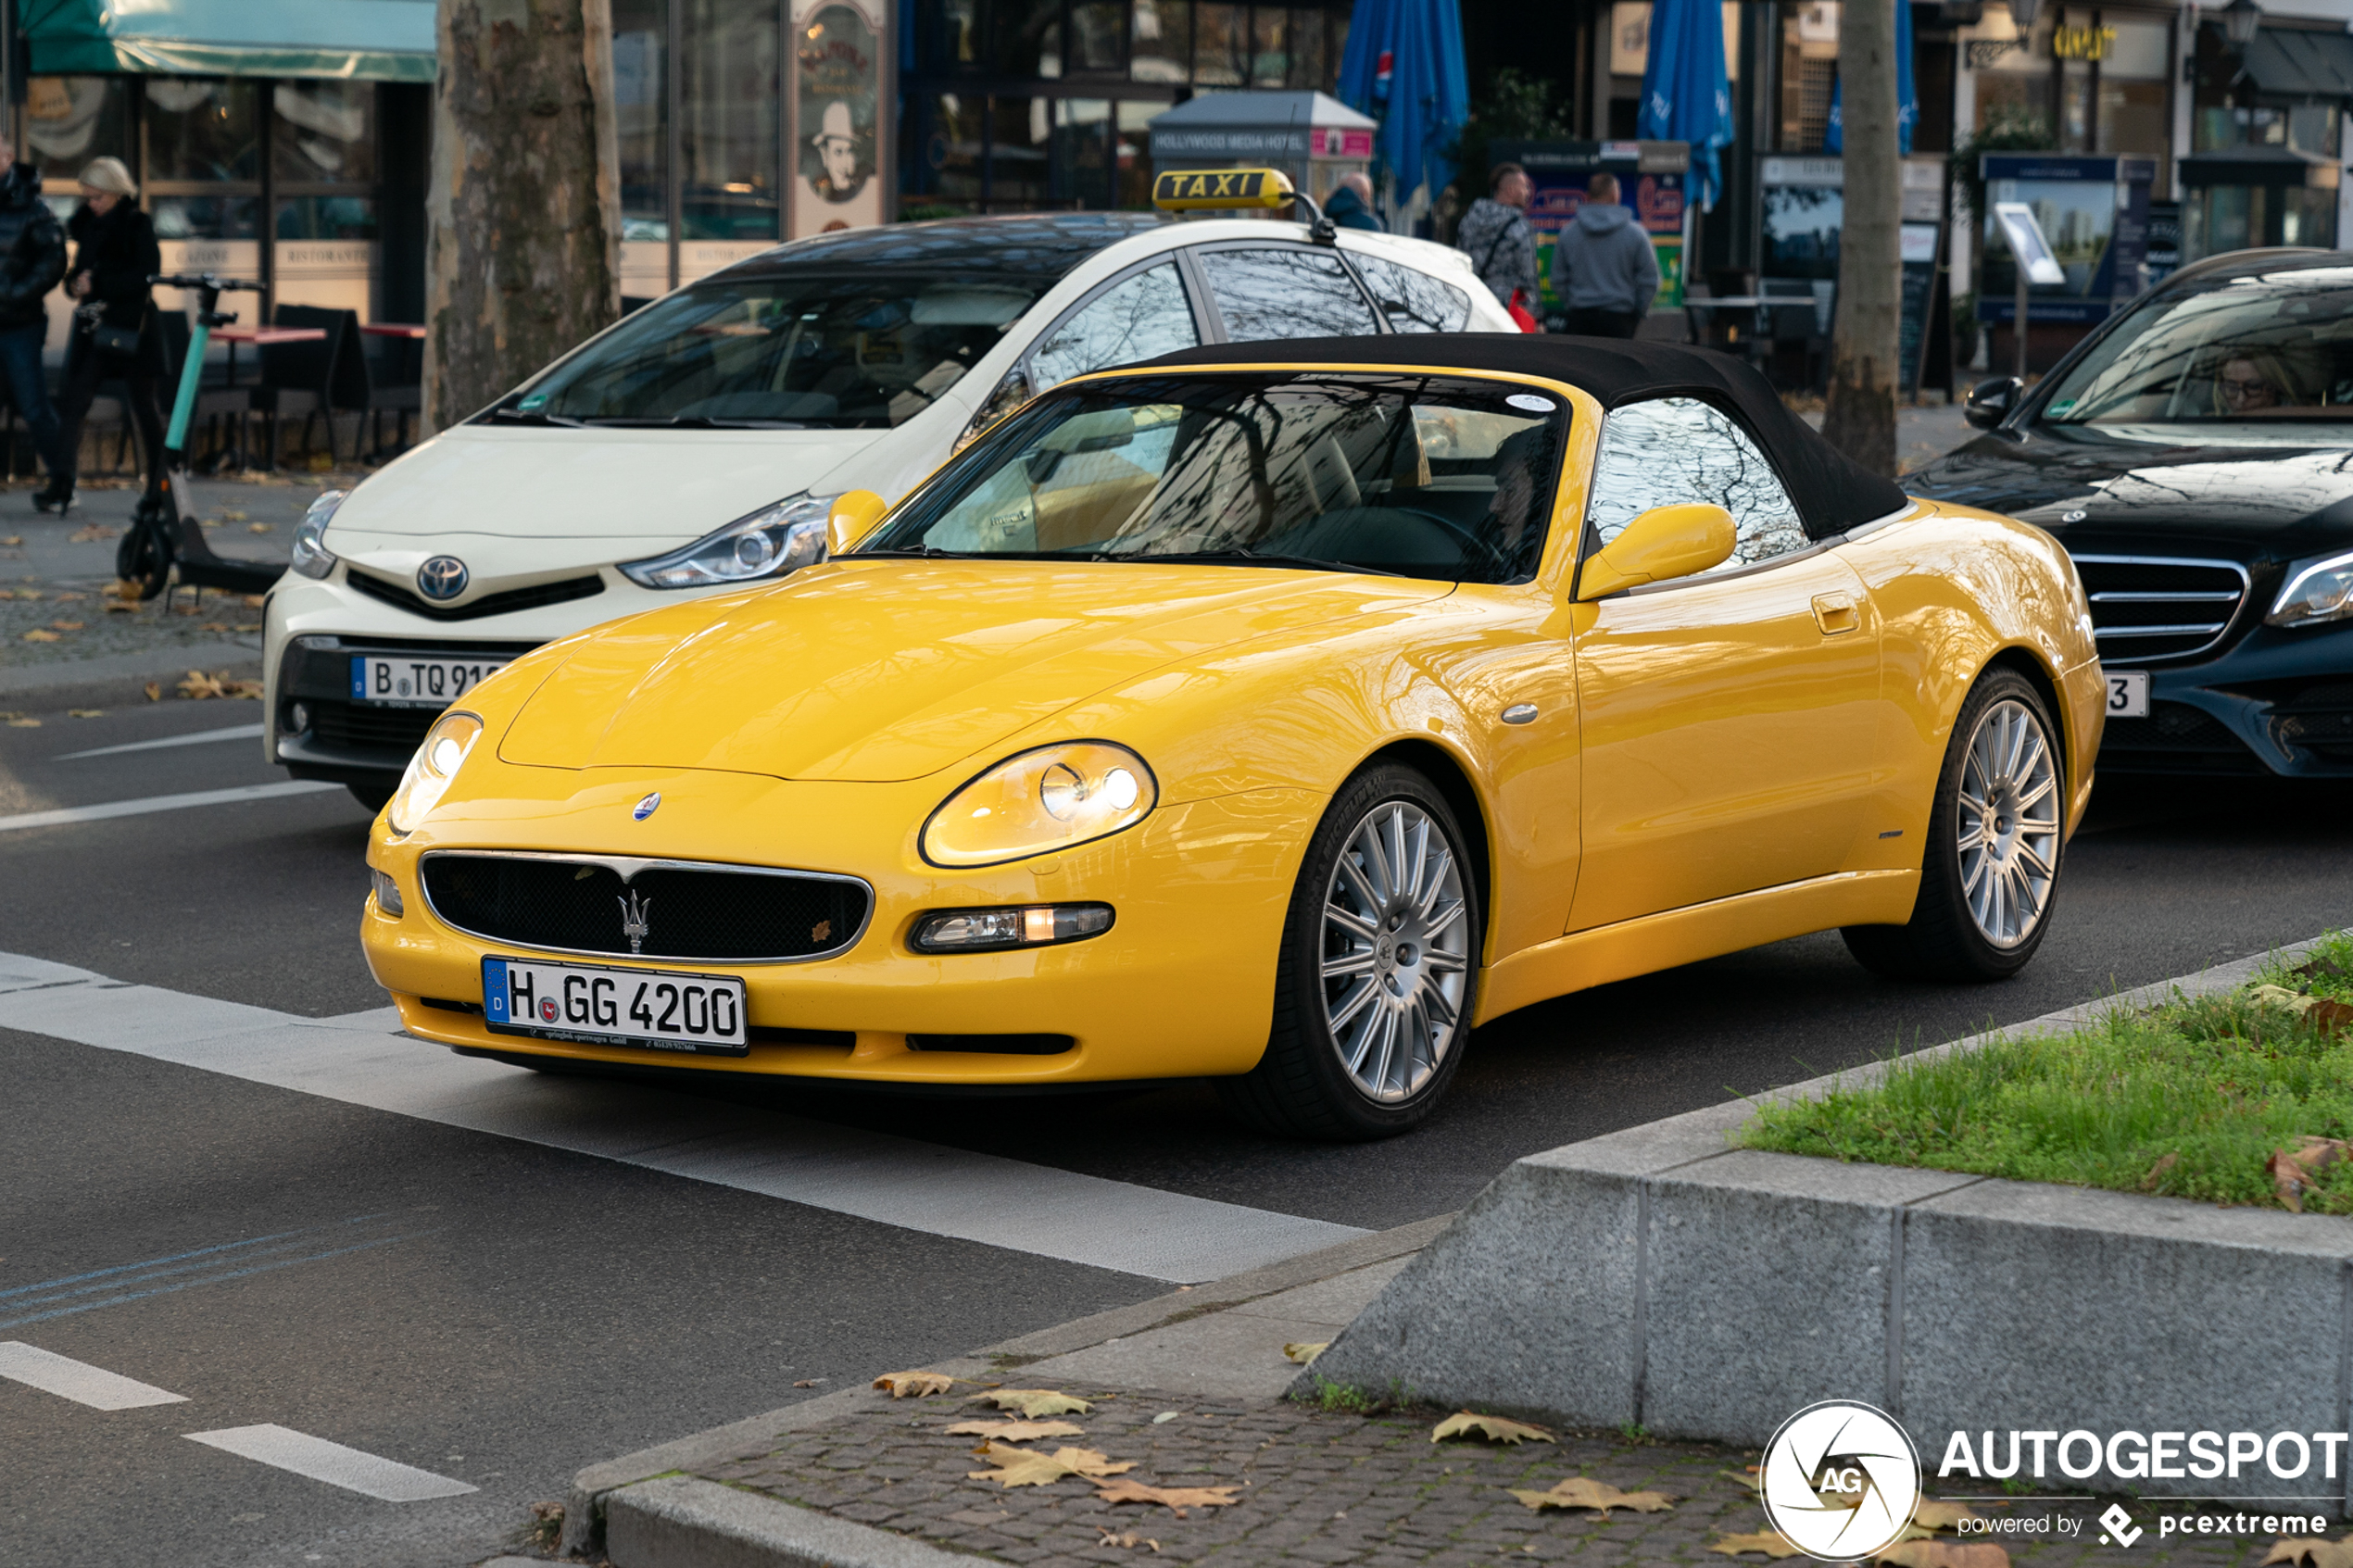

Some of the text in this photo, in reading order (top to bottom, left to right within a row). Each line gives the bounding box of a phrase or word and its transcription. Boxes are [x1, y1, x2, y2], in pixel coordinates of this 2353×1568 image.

[1155, 133, 1226, 149] HOLLYWOOD
[1228, 134, 1263, 150] MEDIA
[1265, 134, 1302, 150] HOTEL
[1172, 174, 1250, 196] TAXI
[376, 663, 499, 696] B TQ 91
[2109, 679, 2128, 710] 3
[1323, 785, 1368, 860] MICHELIN
[493, 997, 503, 1011] D
[509, 970, 736, 1036] H GG 4200
